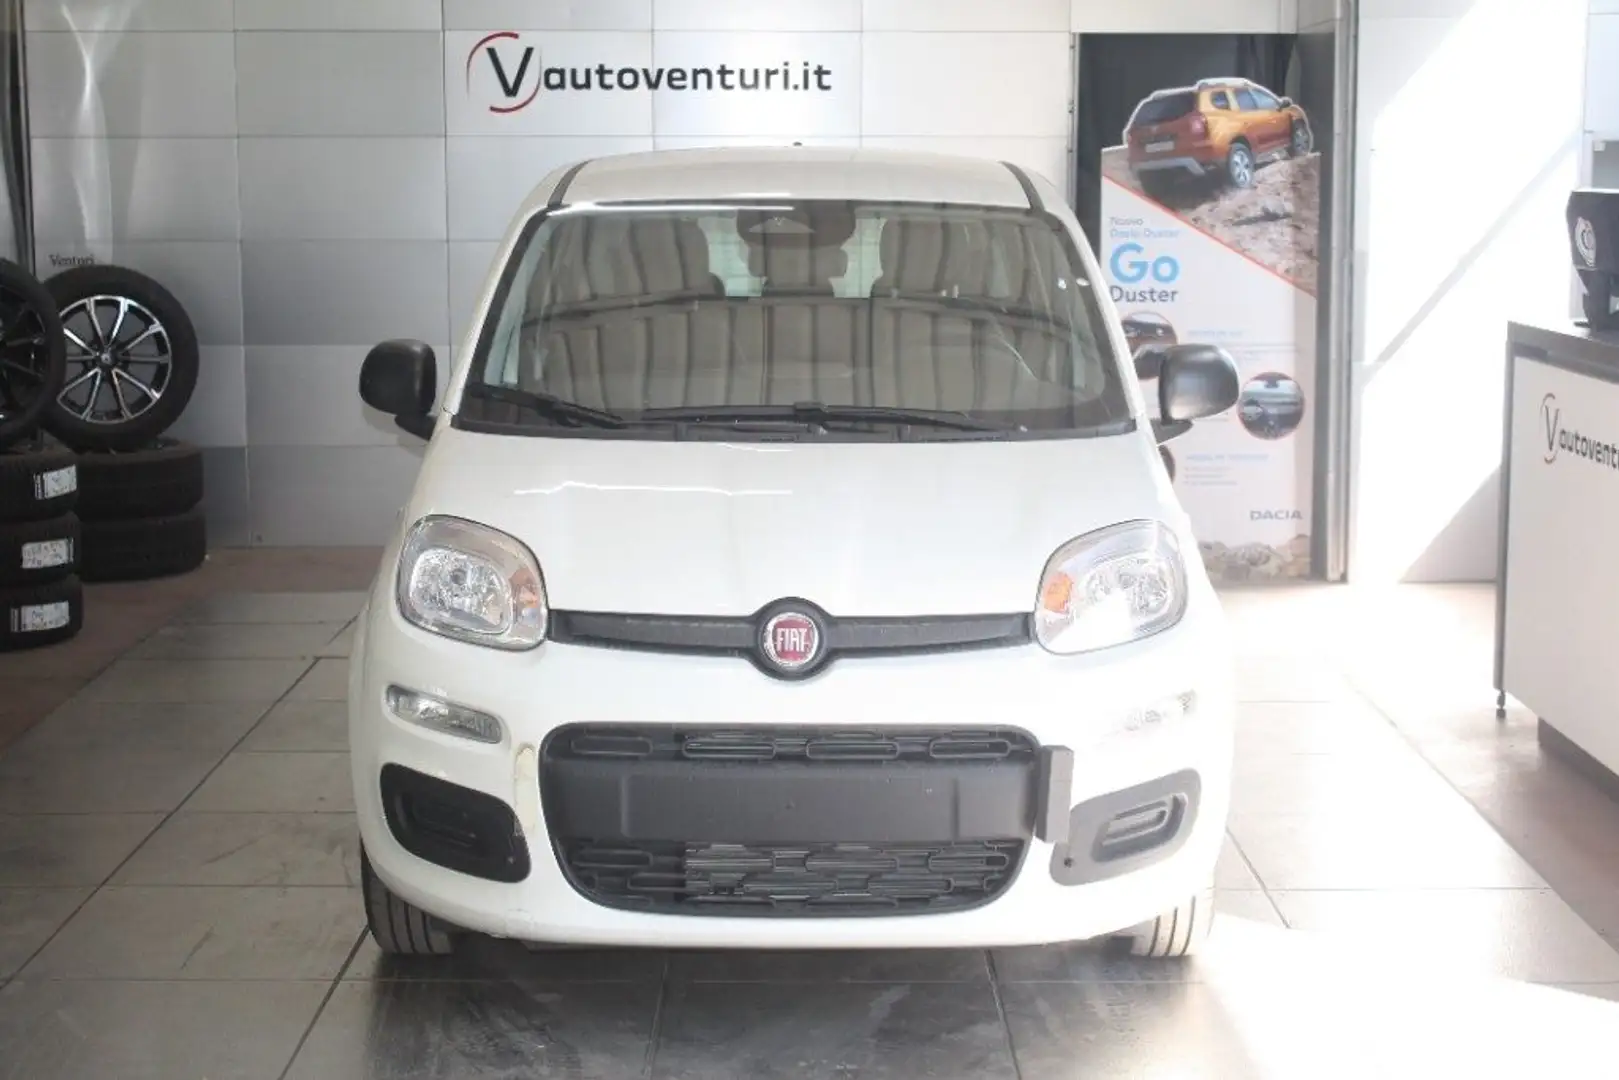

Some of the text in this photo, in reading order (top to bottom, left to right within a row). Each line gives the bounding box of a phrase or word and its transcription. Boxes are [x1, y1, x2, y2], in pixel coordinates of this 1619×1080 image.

[543, 61, 832, 91] autoventuri.it
[1110, 243, 1180, 284] Go
[1109, 286, 1178, 303] Duster
[1559, 429, 1619, 470] autovent
[1250, 510, 1303, 521] DACIA
[776, 628, 807, 652] FIAT
